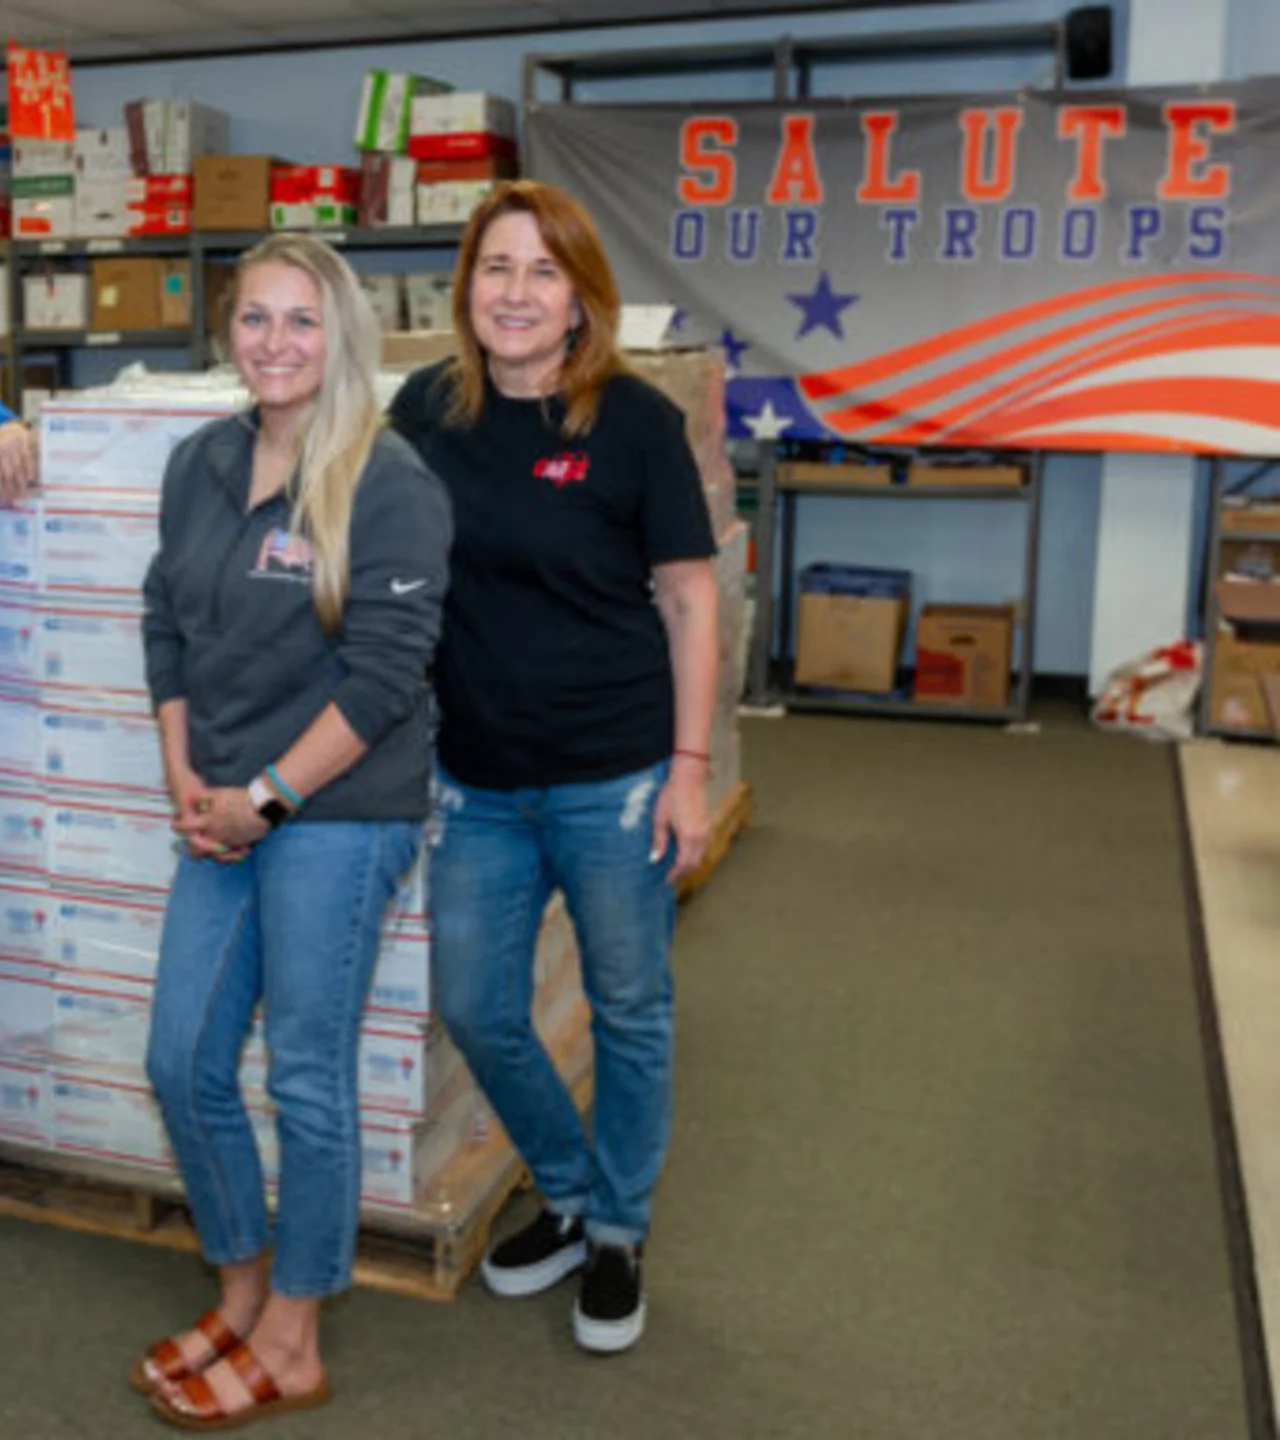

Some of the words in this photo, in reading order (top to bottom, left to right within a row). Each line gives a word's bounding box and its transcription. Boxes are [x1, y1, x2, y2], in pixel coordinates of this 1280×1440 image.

[678, 102, 1236, 205] SALUTE
[673, 207, 817, 261] OUR
[884, 206, 1226, 262] TROOPS
